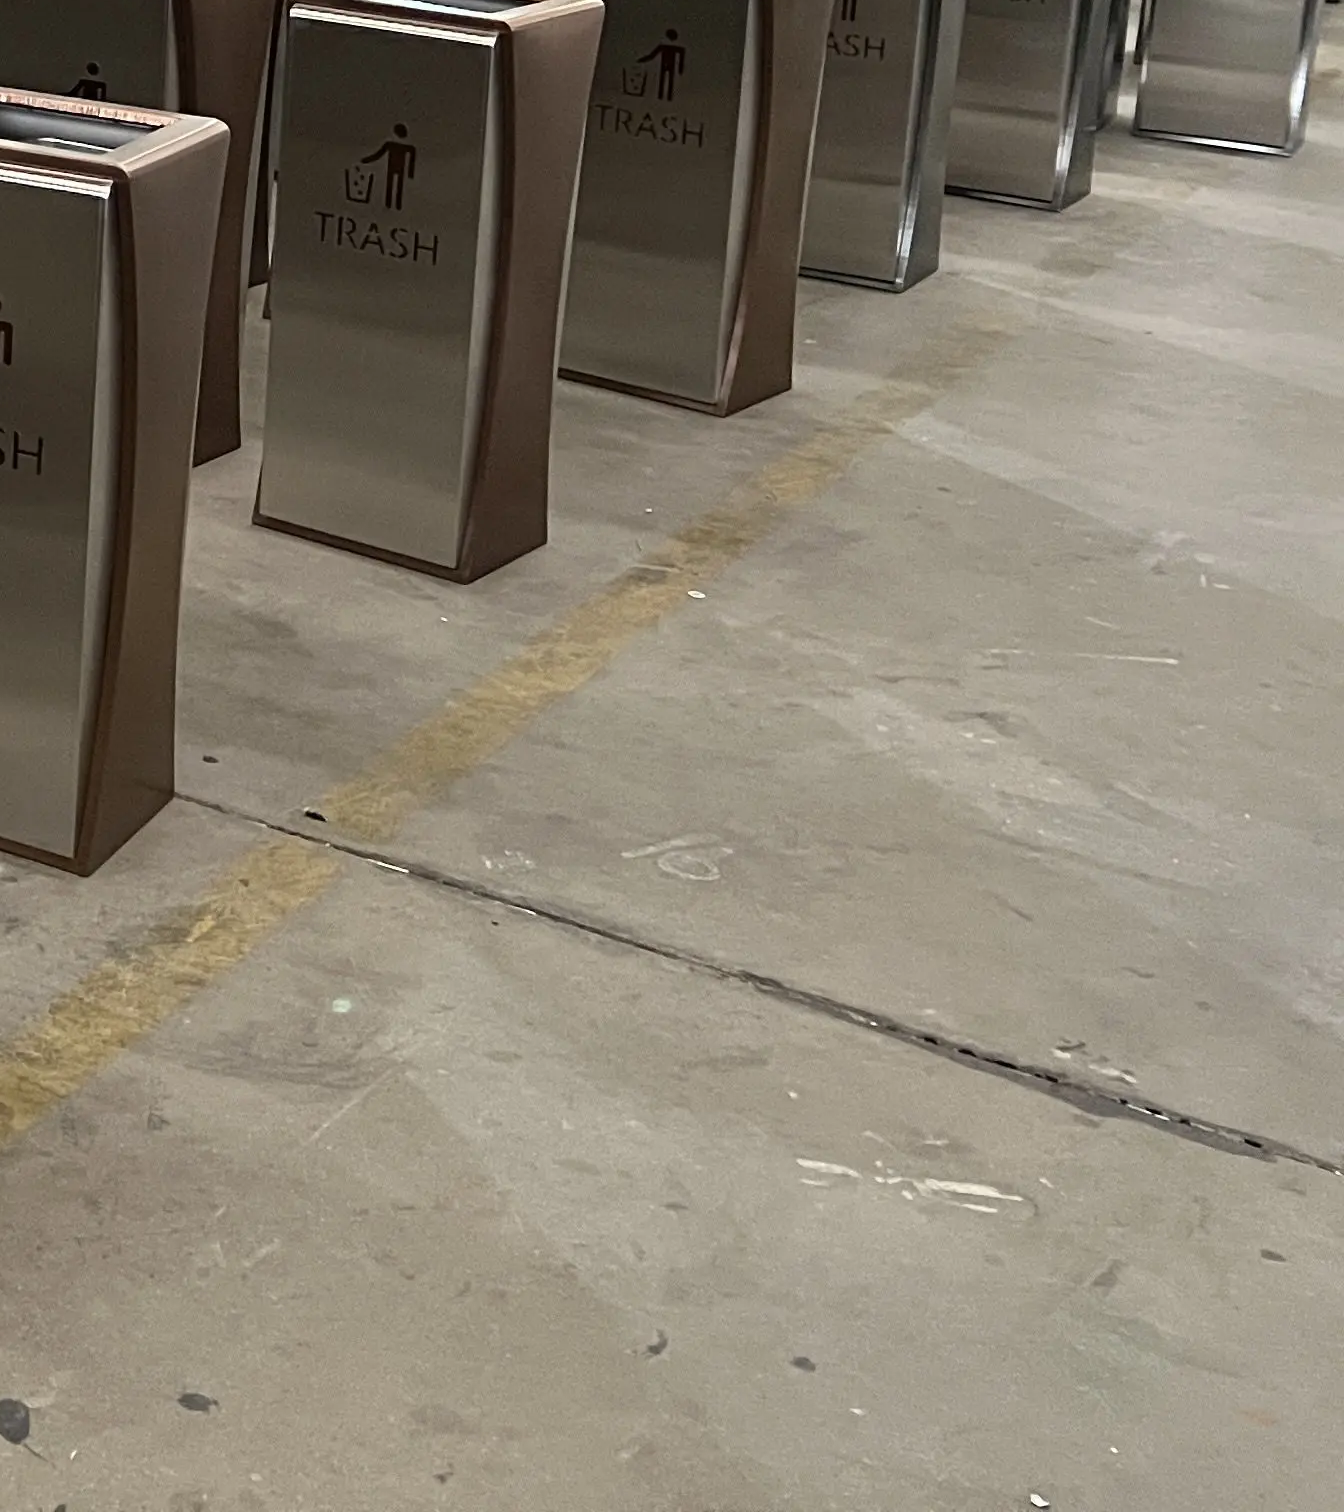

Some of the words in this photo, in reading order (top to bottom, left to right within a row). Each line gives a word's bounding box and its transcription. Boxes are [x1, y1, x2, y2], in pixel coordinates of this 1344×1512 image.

[825, 30, 886, 62] ASH
[594, 103, 705, 149] TRASH
[314, 210, 439, 266] TRASH
